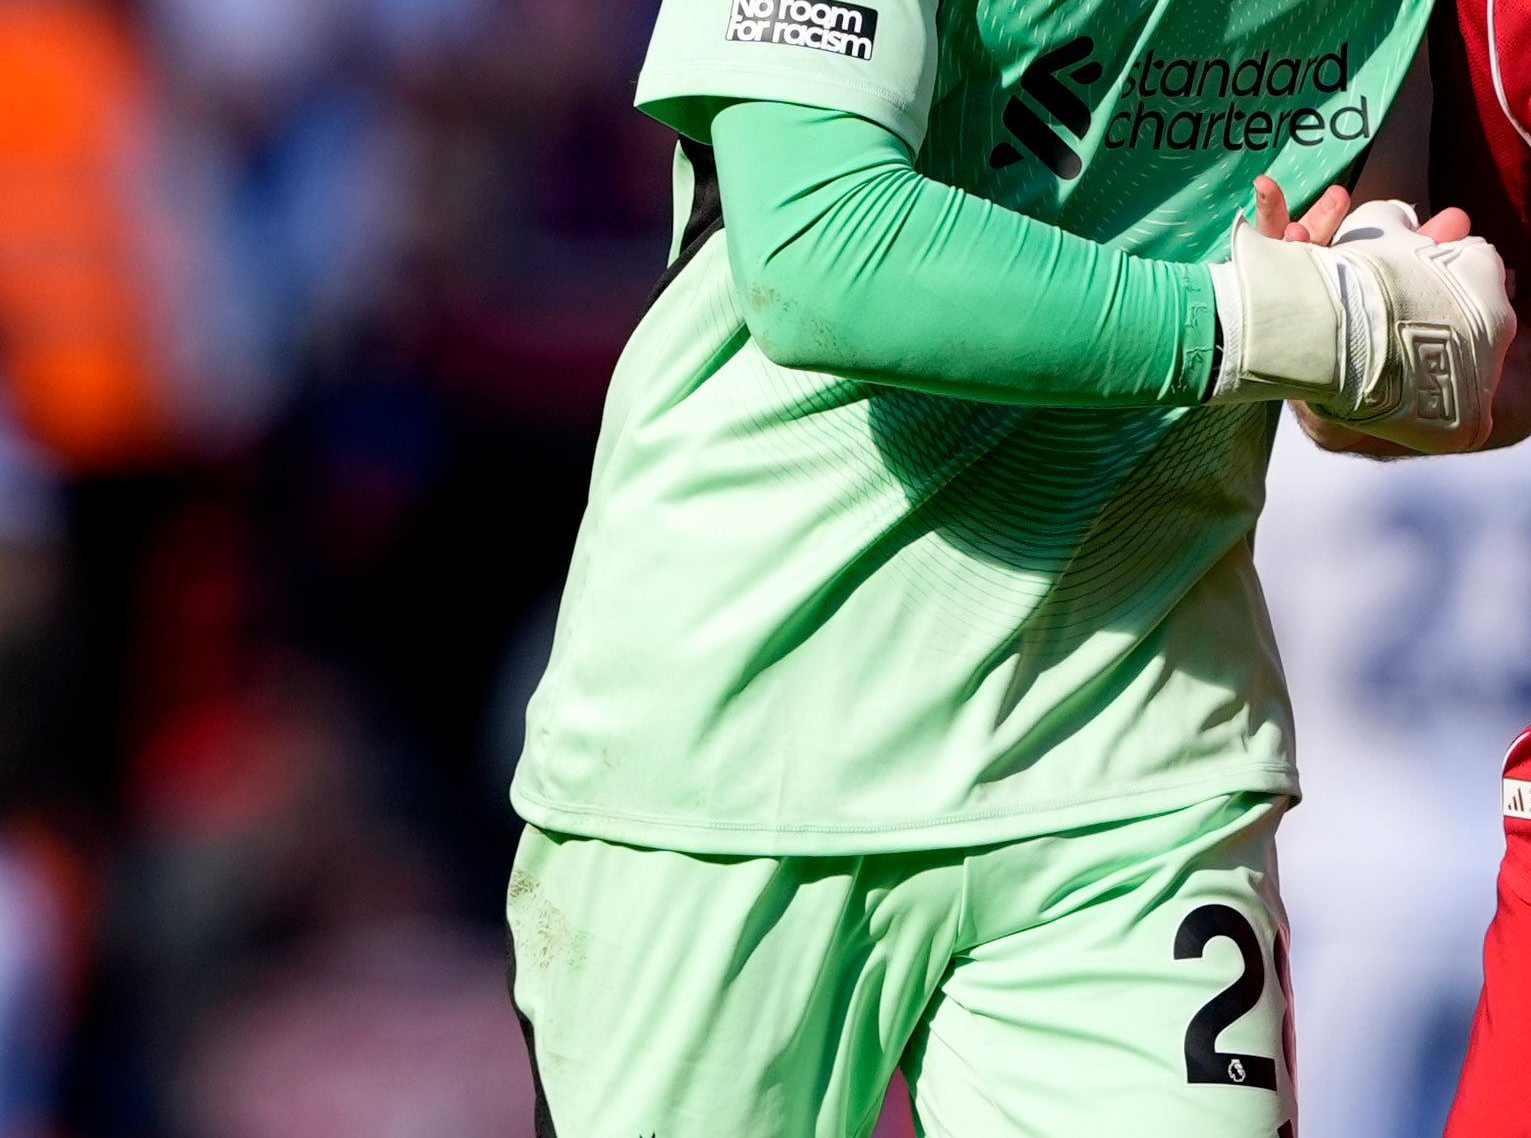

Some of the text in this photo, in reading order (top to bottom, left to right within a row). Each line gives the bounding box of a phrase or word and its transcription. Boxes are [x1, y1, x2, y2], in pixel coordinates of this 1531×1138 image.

[726, 14, 873, 61] for racism
[1120, 41, 1349, 99] standard
[1104, 95, 1372, 152] chartered
